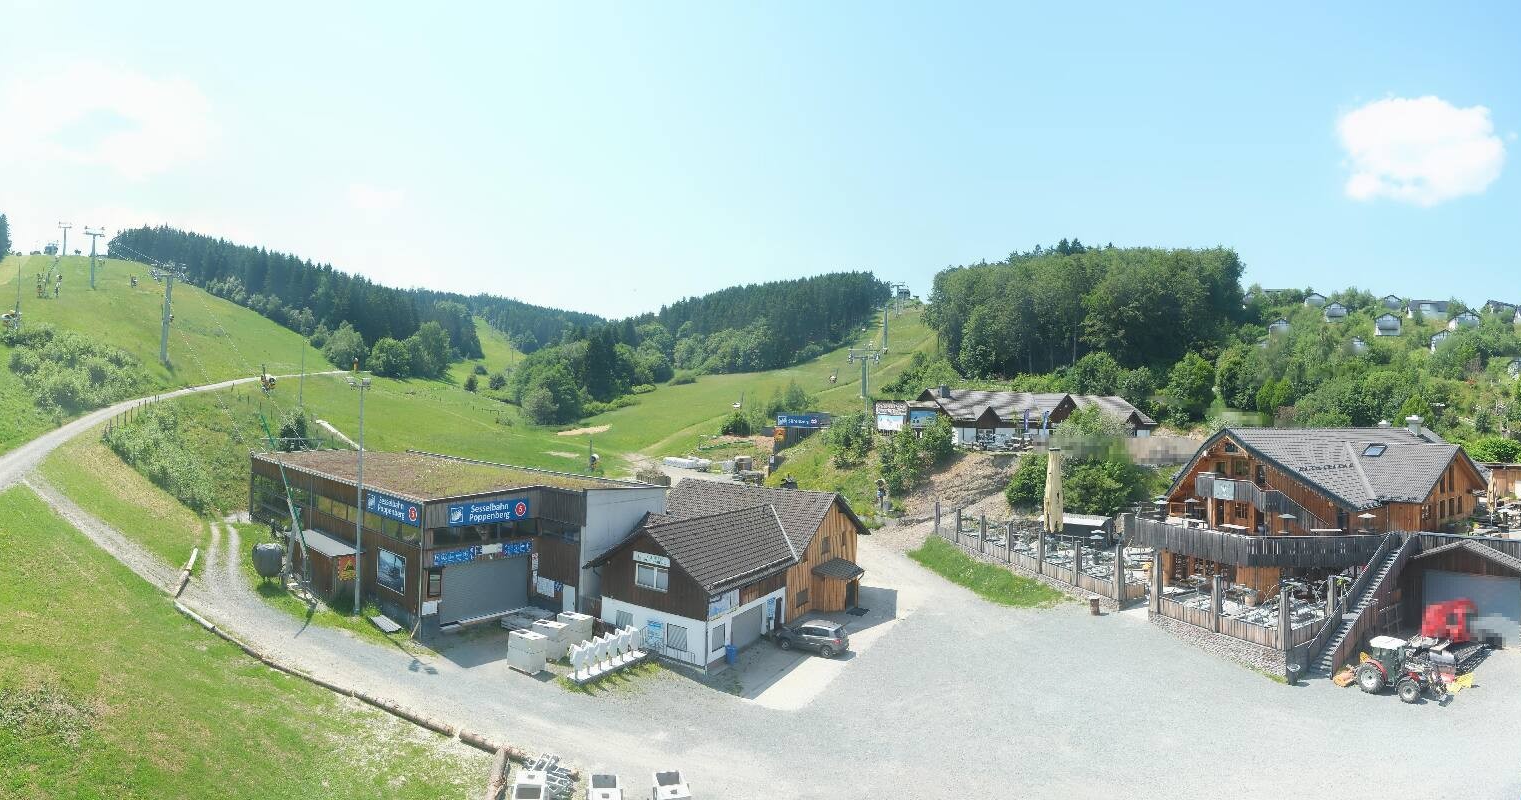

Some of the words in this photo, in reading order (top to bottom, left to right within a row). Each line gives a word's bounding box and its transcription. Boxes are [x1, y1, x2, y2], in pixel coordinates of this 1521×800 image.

[379, 496, 405, 510] Sesselbahn
[470, 503, 509, 513] Sesselbahn
[469, 511, 510, 522] Poppenberg
